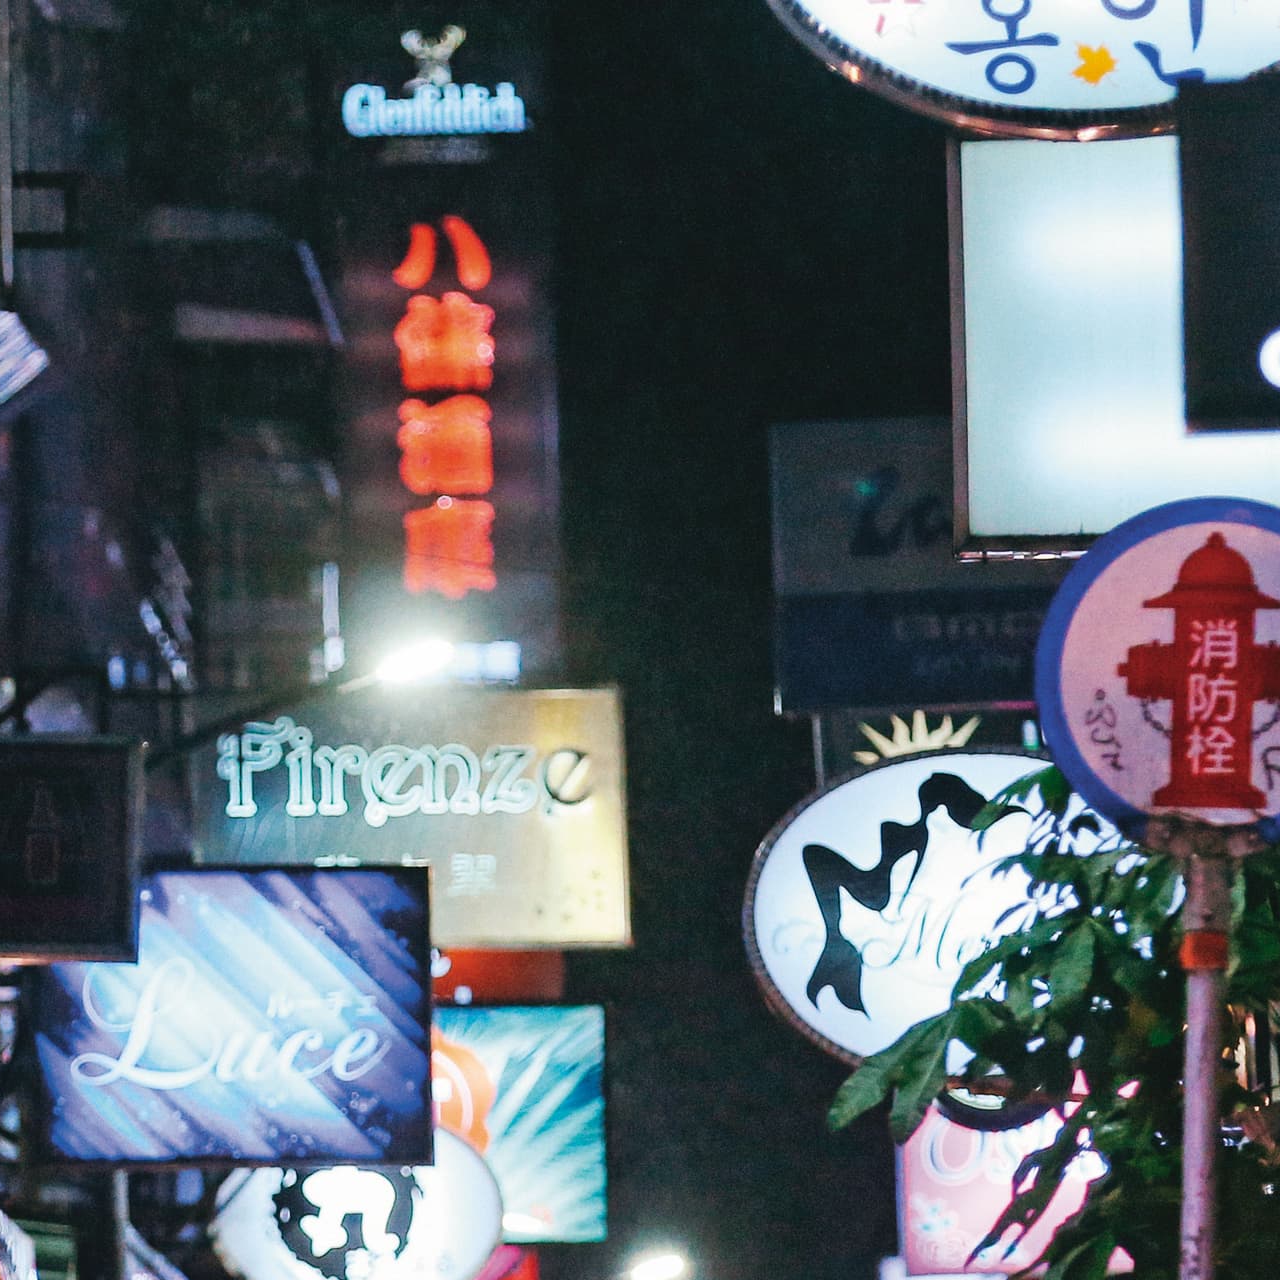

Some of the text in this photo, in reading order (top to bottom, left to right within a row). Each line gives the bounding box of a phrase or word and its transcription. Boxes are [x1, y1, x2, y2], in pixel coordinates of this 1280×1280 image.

[1187, 617, 1241, 776] 消防栓
[70, 955, 394, 1090] Luce
